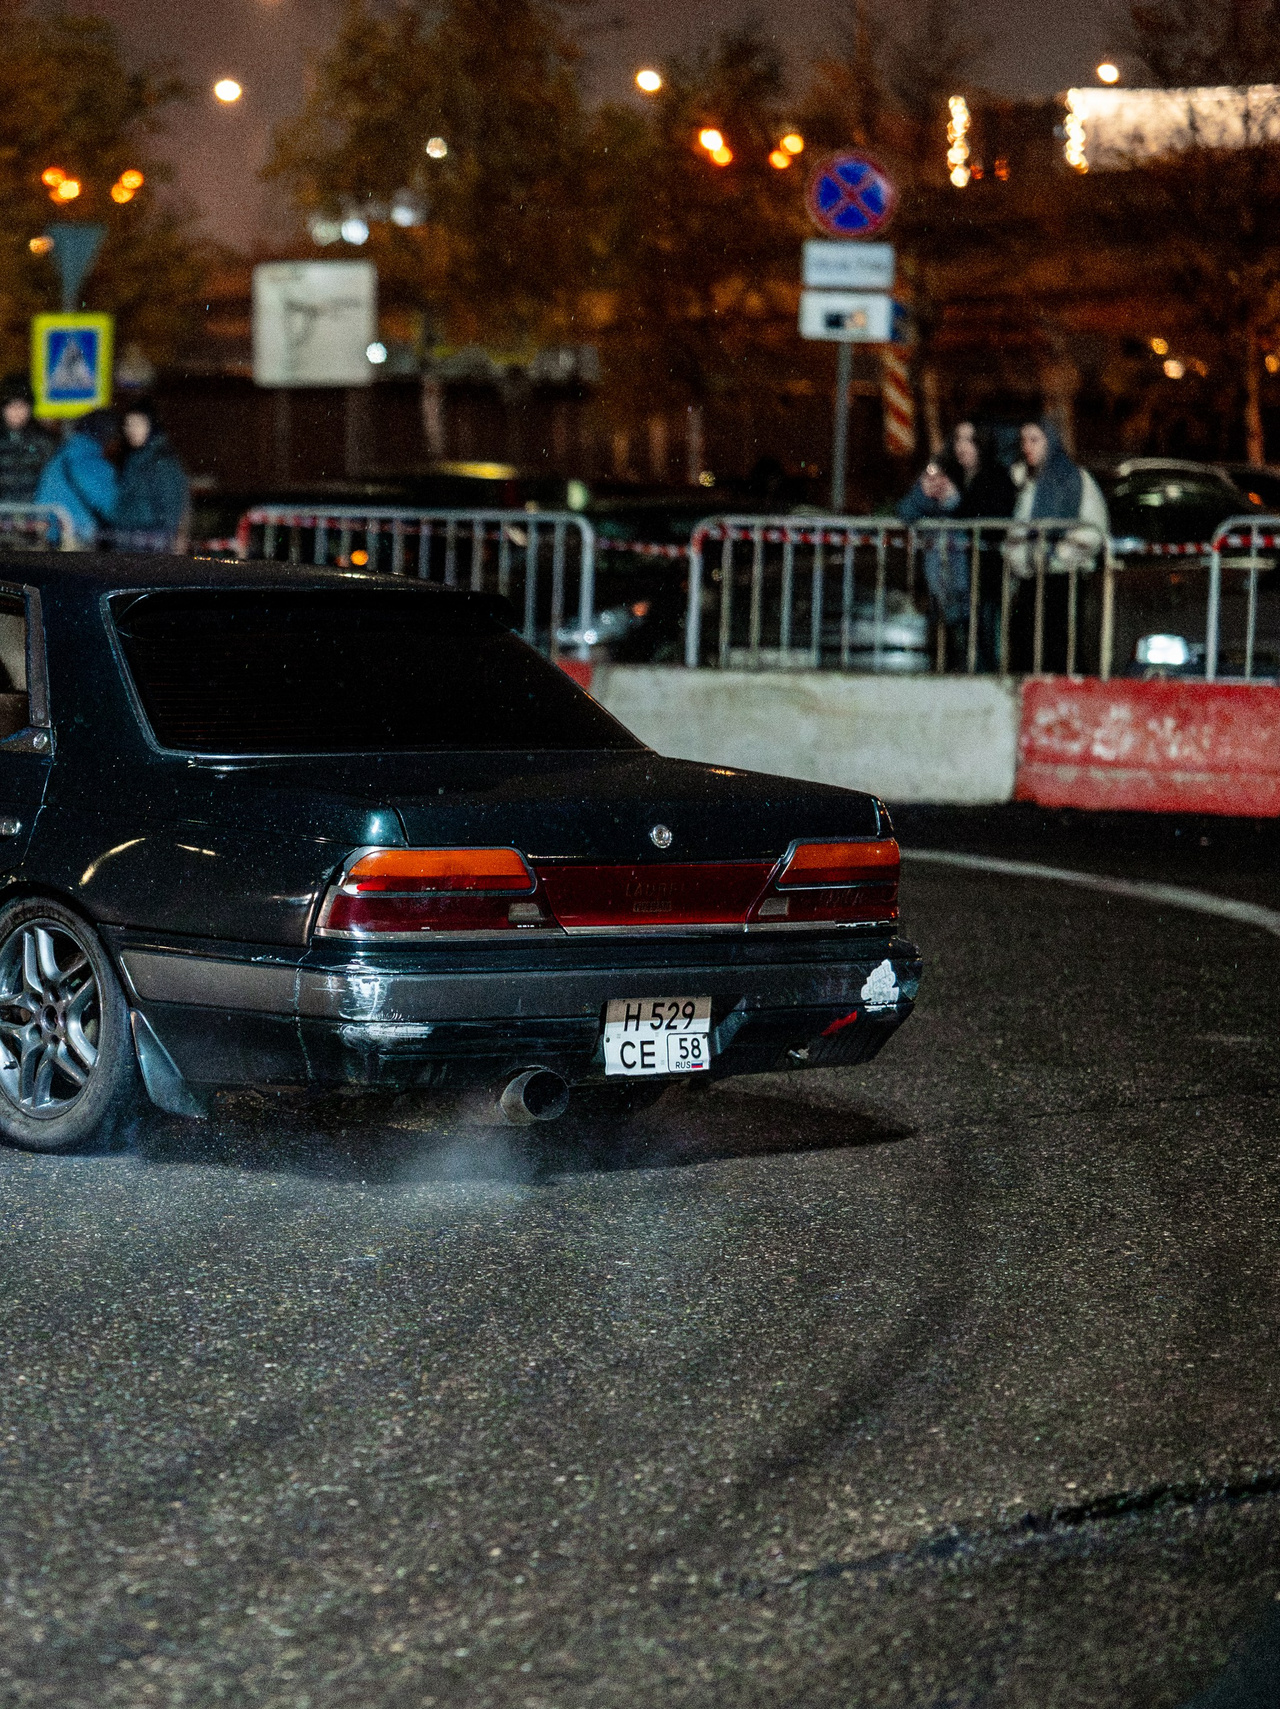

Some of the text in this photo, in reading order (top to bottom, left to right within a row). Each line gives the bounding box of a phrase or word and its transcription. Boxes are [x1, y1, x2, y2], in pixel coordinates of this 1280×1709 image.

[649, 1001, 696, 1031] 529
[678, 1037, 702, 1060] 58
[675, 1060, 691, 1069] RUS
